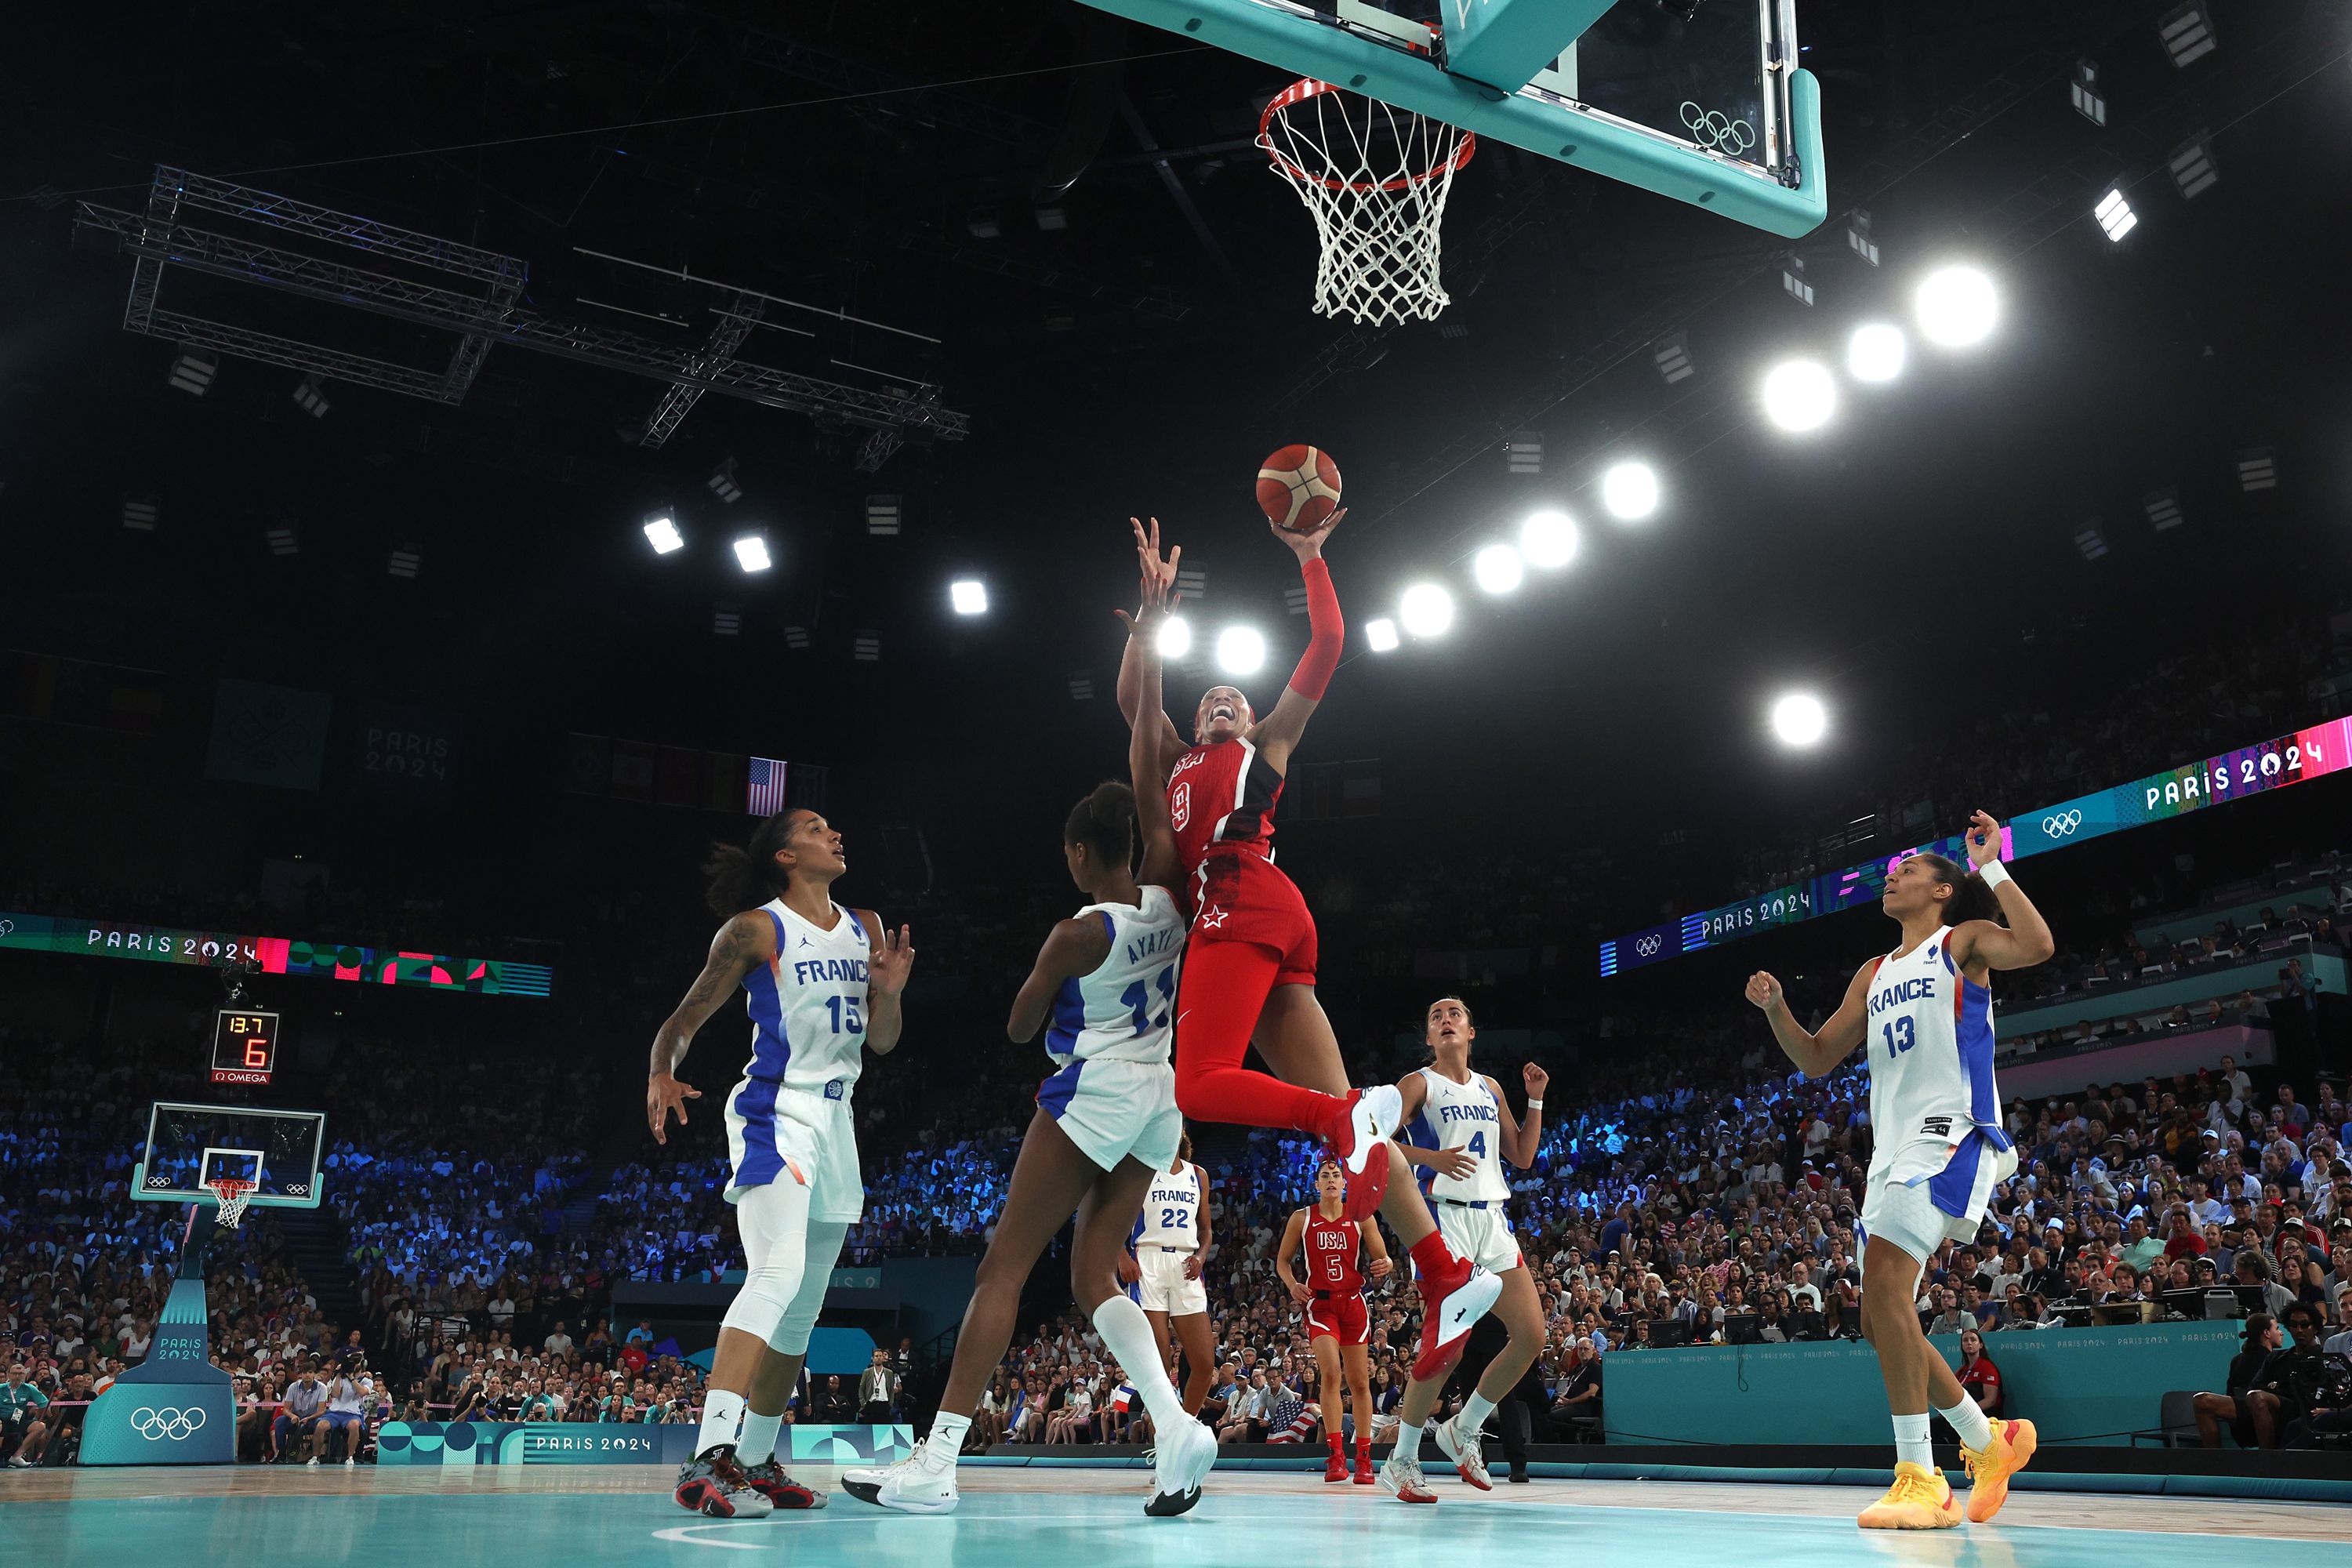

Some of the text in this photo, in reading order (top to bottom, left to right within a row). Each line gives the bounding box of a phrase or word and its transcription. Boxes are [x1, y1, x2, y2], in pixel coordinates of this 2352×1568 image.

[2241, 742, 2322, 784] 2024
[1171, 782, 1190, 832] 9
[1761, 892, 1810, 920] 2024
[183, 939, 256, 960] 2024
[794, 959, 871, 985] FRANC
[230, 1017, 263, 1033] 13.7
[825, 996, 863, 1034] 15
[1882, 1014, 1915, 1058] 13
[245, 1039, 267, 1067] 6
[227, 1073, 267, 1083] OMEGA
[1468, 1131, 1486, 1159] 4
[1152, 1190, 1196, 1204] FRANCE
[1161, 1208, 1189, 1229] 22
[1317, 1231, 1347, 1250] USA
[1326, 1254, 1343, 1281] 5
[2083, 1338, 2106, 1347] 2024
[2145, 1336, 2169, 1345] 2024
[2211, 1332, 2235, 1341] 2024
[158, 1349, 200, 1360] 2024
[601, 1438, 651, 1450] 2024
